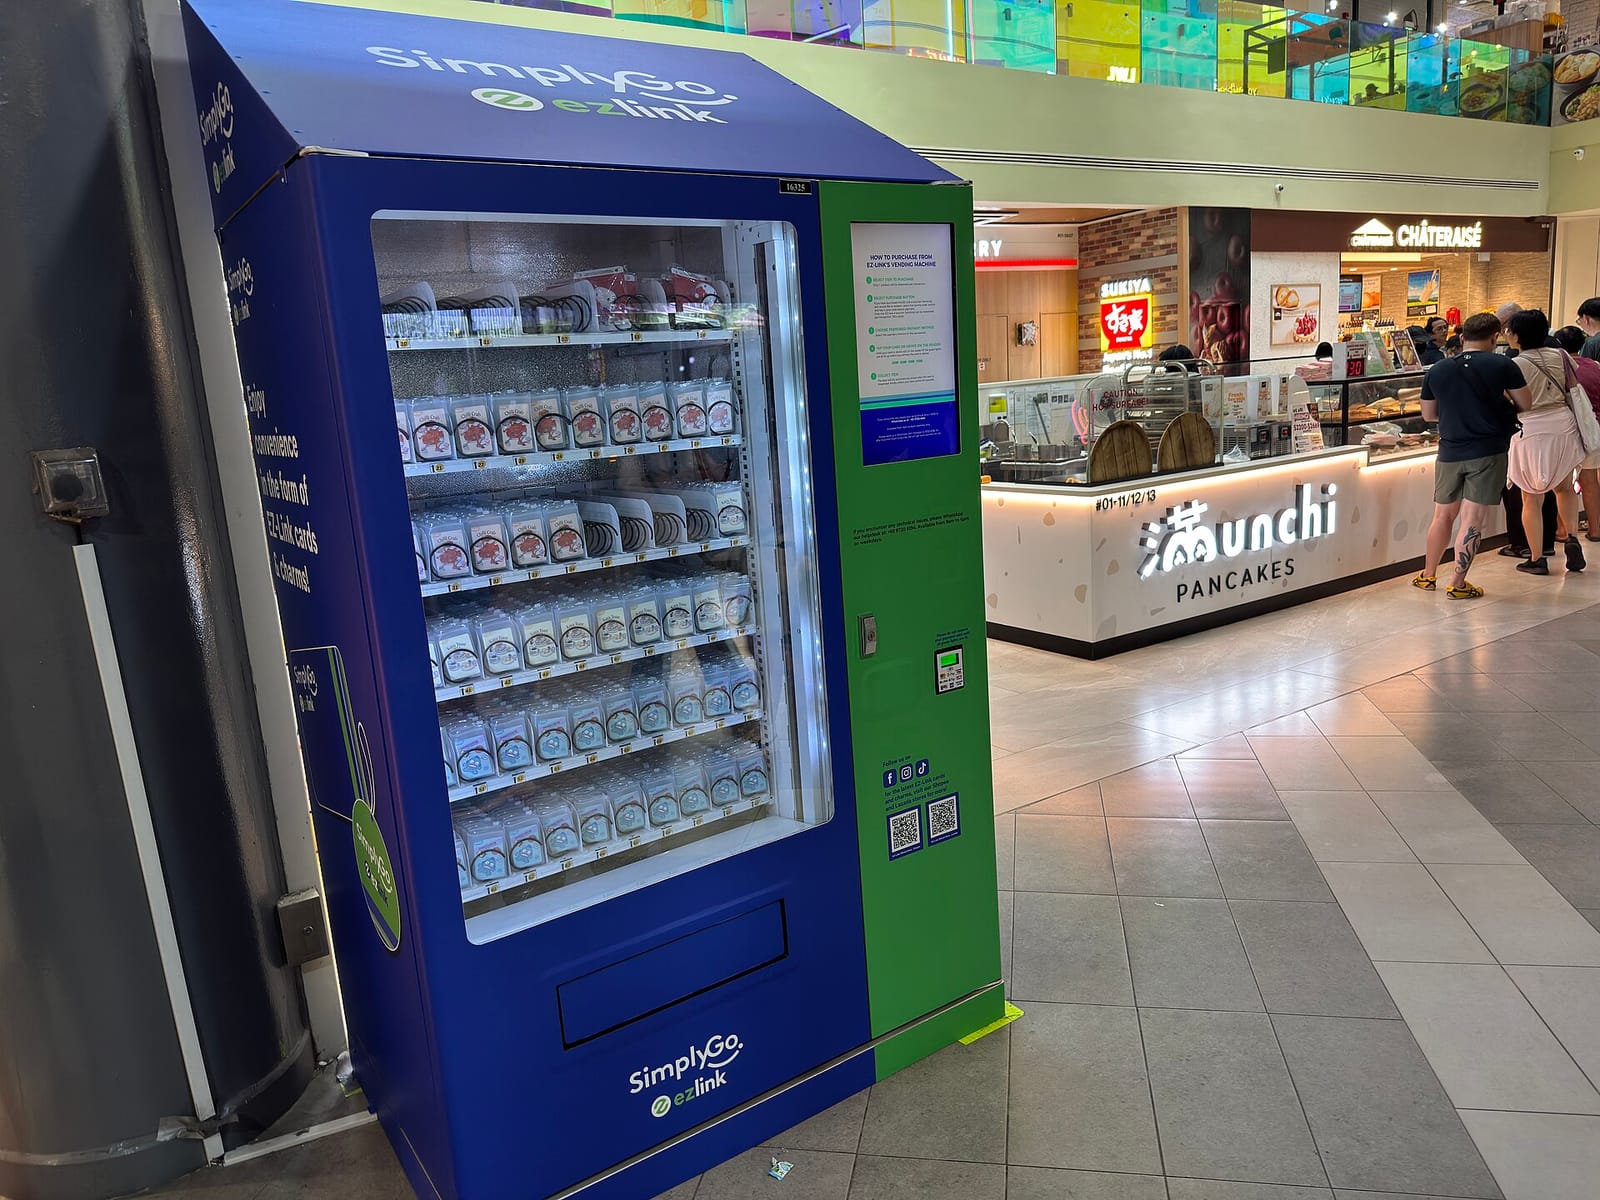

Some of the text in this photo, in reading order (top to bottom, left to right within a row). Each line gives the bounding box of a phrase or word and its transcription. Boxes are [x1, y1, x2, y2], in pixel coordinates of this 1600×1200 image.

[553, 95, 728, 125] ezlink
[974, 239, 1003, 257] RY
[1101, 277, 1152, 298] SUKIYA
[246, 384, 267, 419] Enjoy
[1103, 388, 1138, 399] CAUTION
[254, 426, 299, 459] convenience
[260, 470, 309, 506] in the form of
[1096, 490, 1157, 512] #01-11/12/13
[266, 510, 319, 555] EZ-Link cards
[279, 554, 311, 594] charms!
[1176, 558, 1296, 603] PANCAKES
[673, 1069, 728, 1106] ezlink
